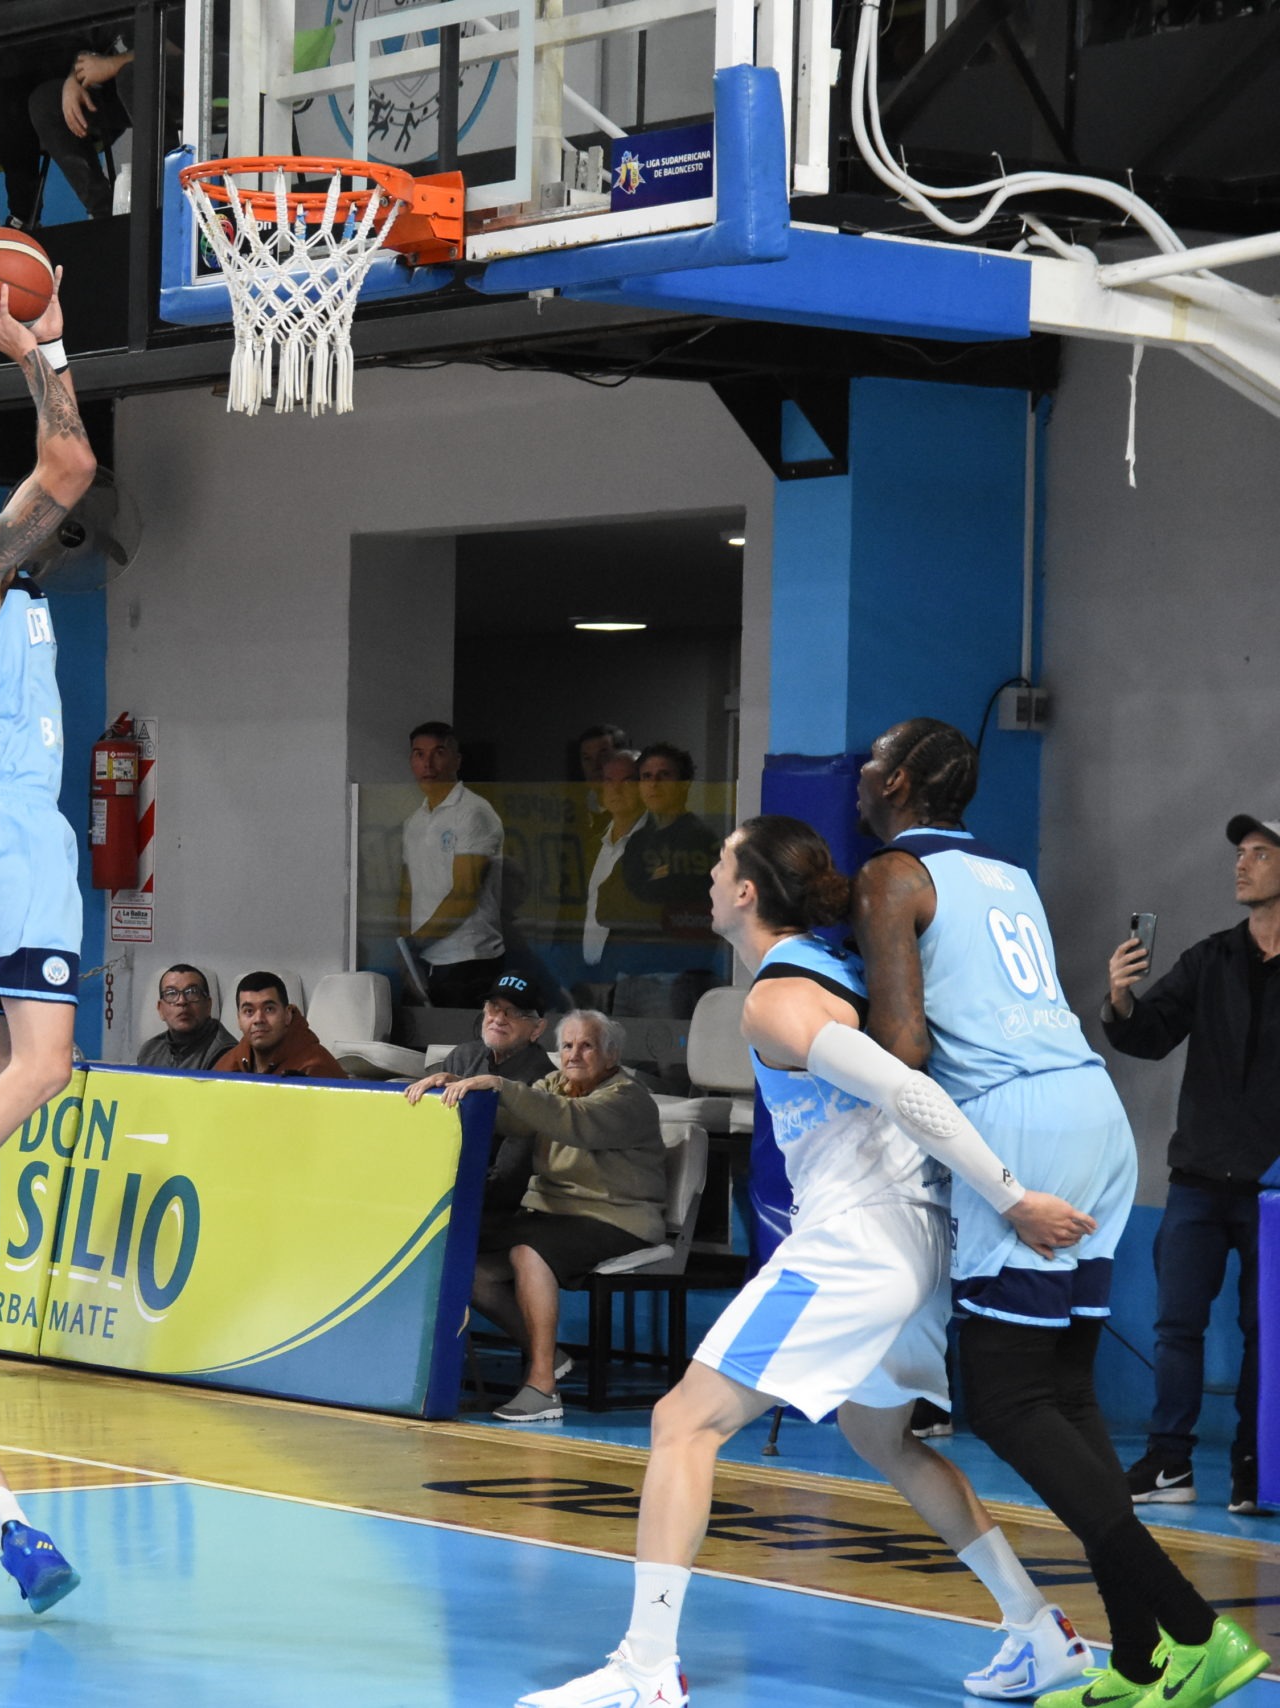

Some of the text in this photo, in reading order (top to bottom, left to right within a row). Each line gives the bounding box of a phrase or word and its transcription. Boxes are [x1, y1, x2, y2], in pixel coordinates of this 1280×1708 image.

[645, 150, 711, 169] LIGA SUDAMERICANA
[653, 168, 663, 178] DE
[663, 162, 704, 177] BALONCESTO
[986, 906, 1059, 1004] 60
[498, 976, 528, 992] OTC
[18, 1095, 119, 1162] DON
[48, 1299, 119, 1340] MATE
